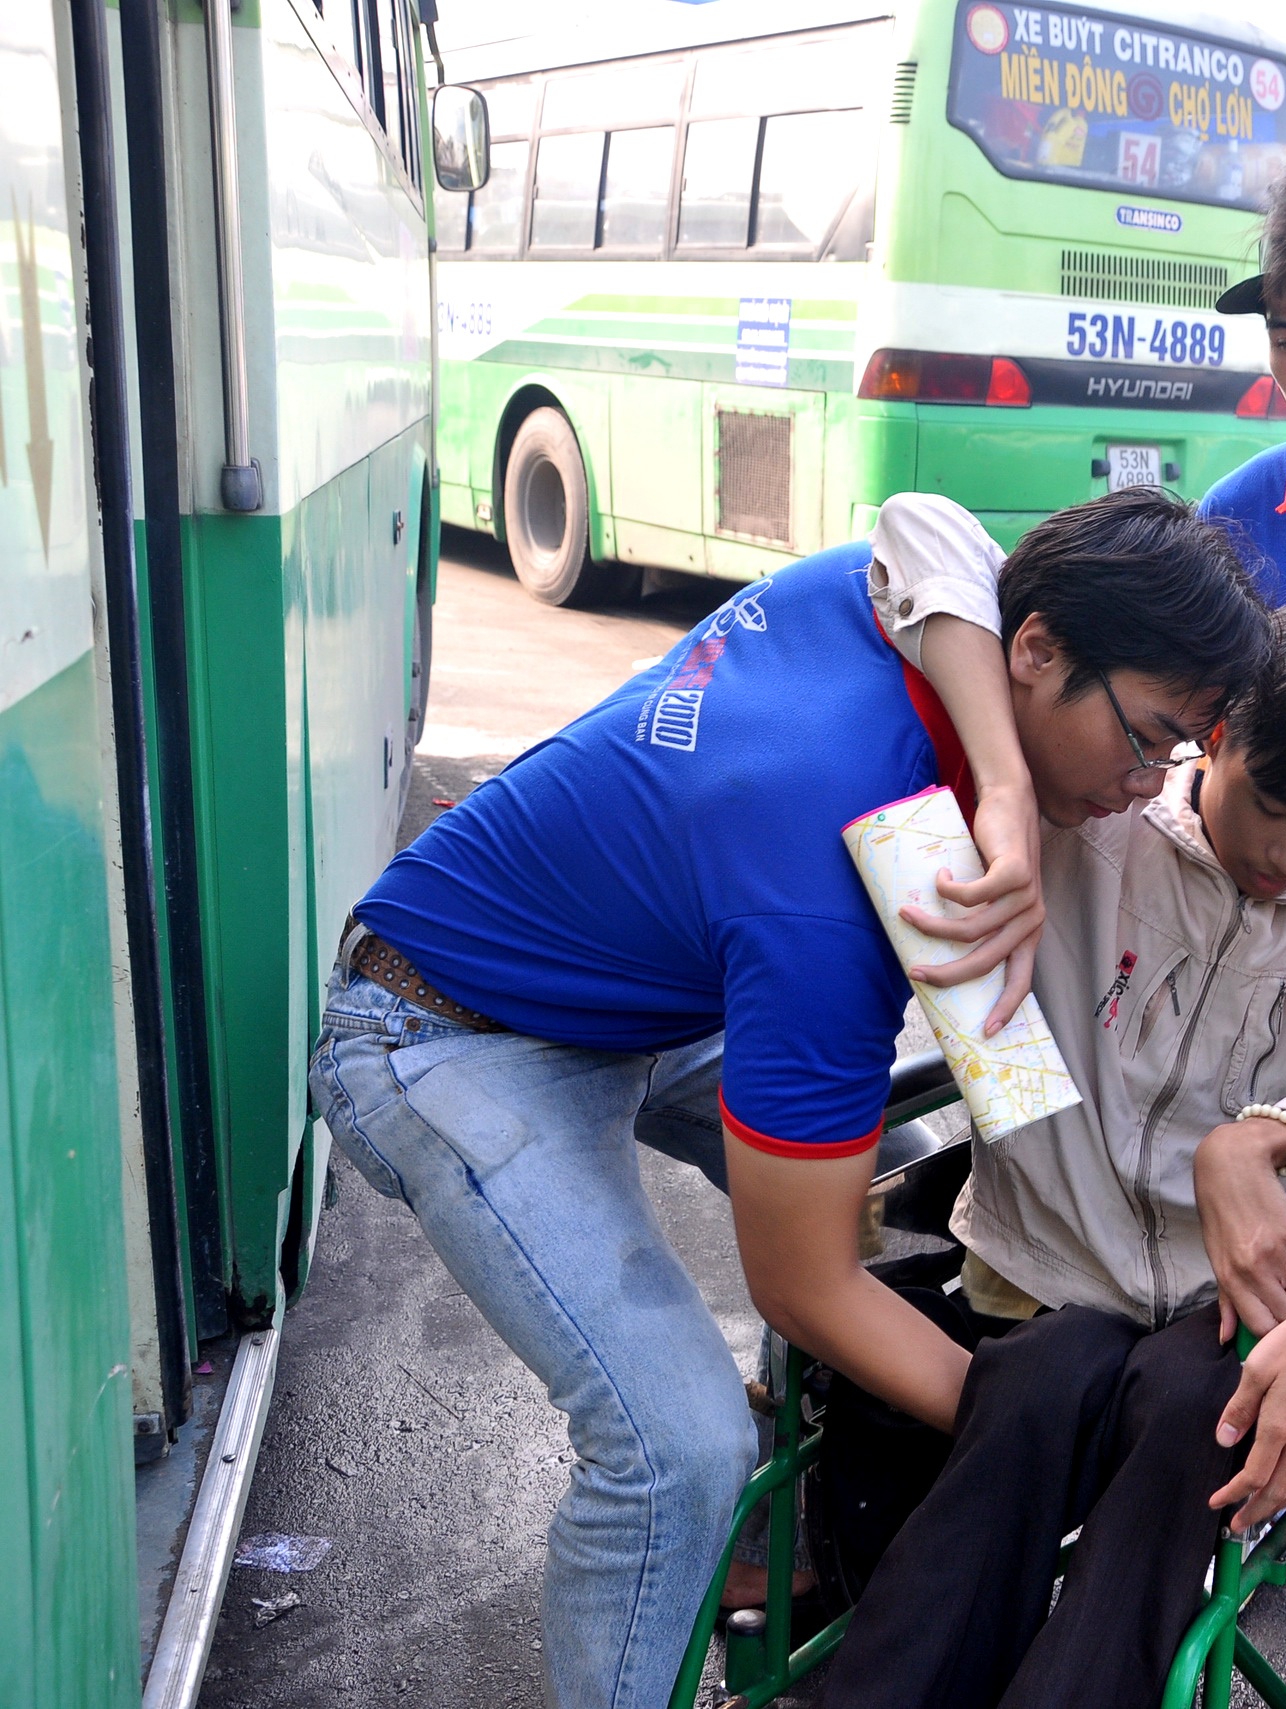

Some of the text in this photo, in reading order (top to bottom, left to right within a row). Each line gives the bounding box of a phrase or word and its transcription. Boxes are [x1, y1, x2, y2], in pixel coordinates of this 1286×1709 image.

[1013, 8, 1245, 86] XE BUÝT CITRANCO
[1065, 54, 1128, 118] ĐÔNG
[1255, 70, 1281, 102] 54
[1122, 139, 1157, 187] 54
[1119, 207, 1180, 230] TRANSINCO
[1067, 312, 1225, 367] 53N-4889
[1087, 377, 1193, 400] HYUNDAI
[1120, 449, 1149, 470] 53N
